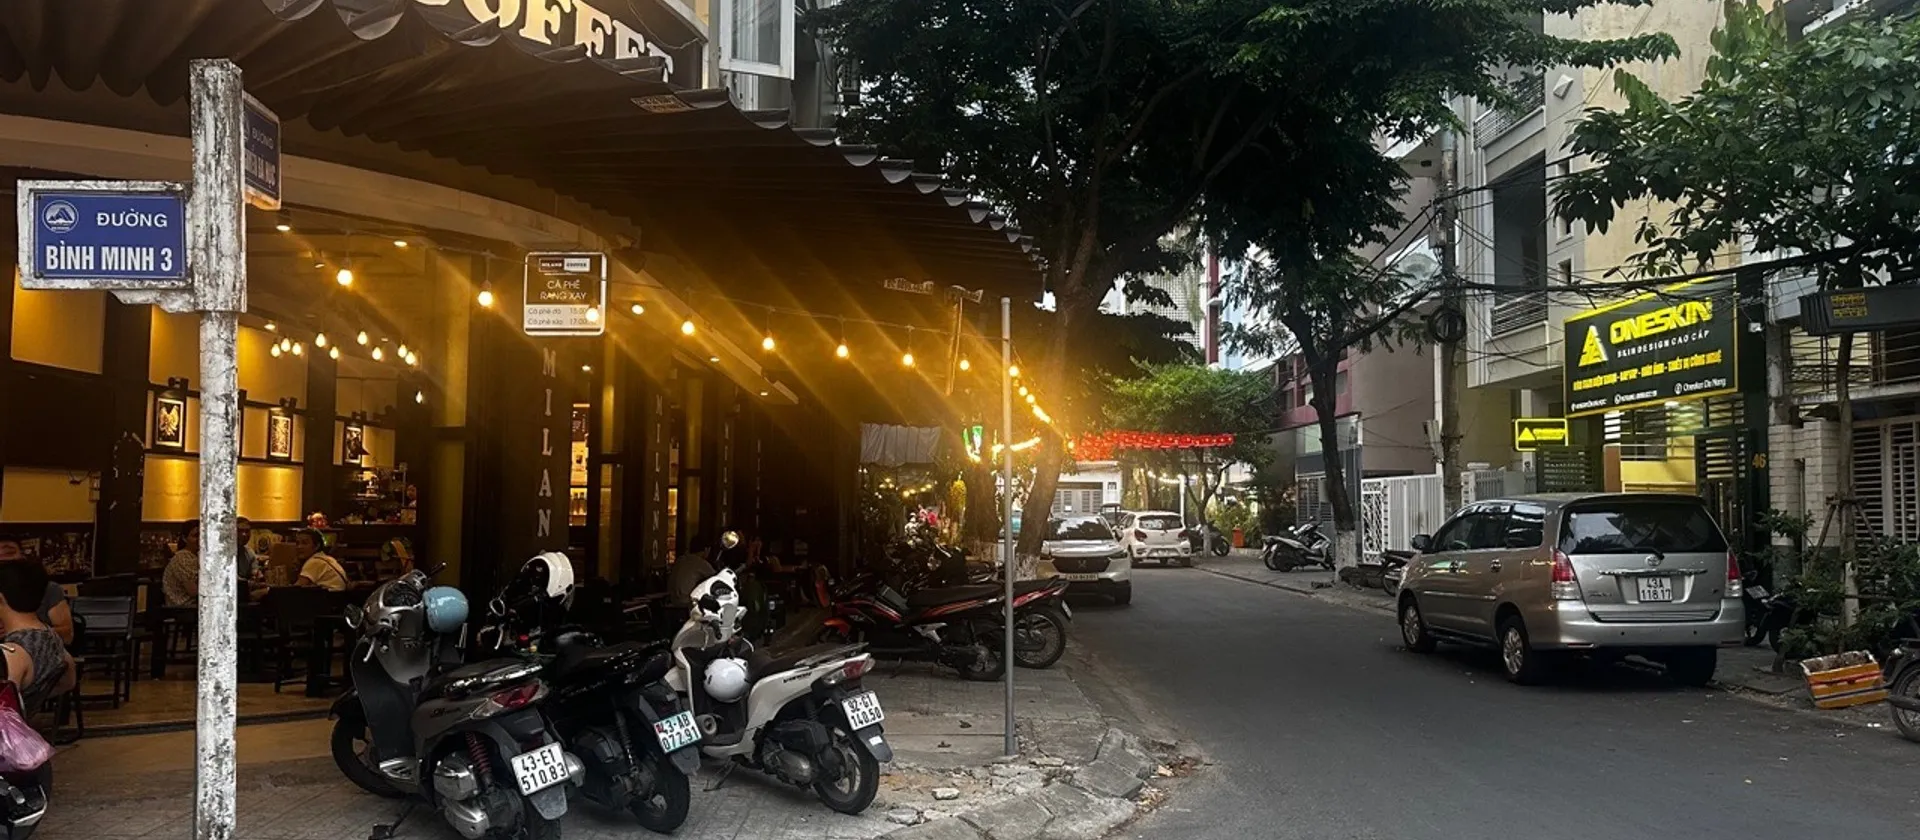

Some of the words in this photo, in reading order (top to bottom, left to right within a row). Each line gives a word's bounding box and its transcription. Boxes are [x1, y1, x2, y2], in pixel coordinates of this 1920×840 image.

[96, 208, 168, 228] ĐƯỜNG
[45, 240, 95, 270] BÌNH
[101, 246, 154, 271] MINH
[160, 247, 173, 271] 3
[569, 292, 587, 300] XAY
[1609, 297, 1713, 345] ONESKIN
[537, 347, 556, 553] MILAN
[1646, 577, 1664, 588] 43A
[521, 748, 556, 772] 43-E1
[520, 762, 567, 791] 510.83
